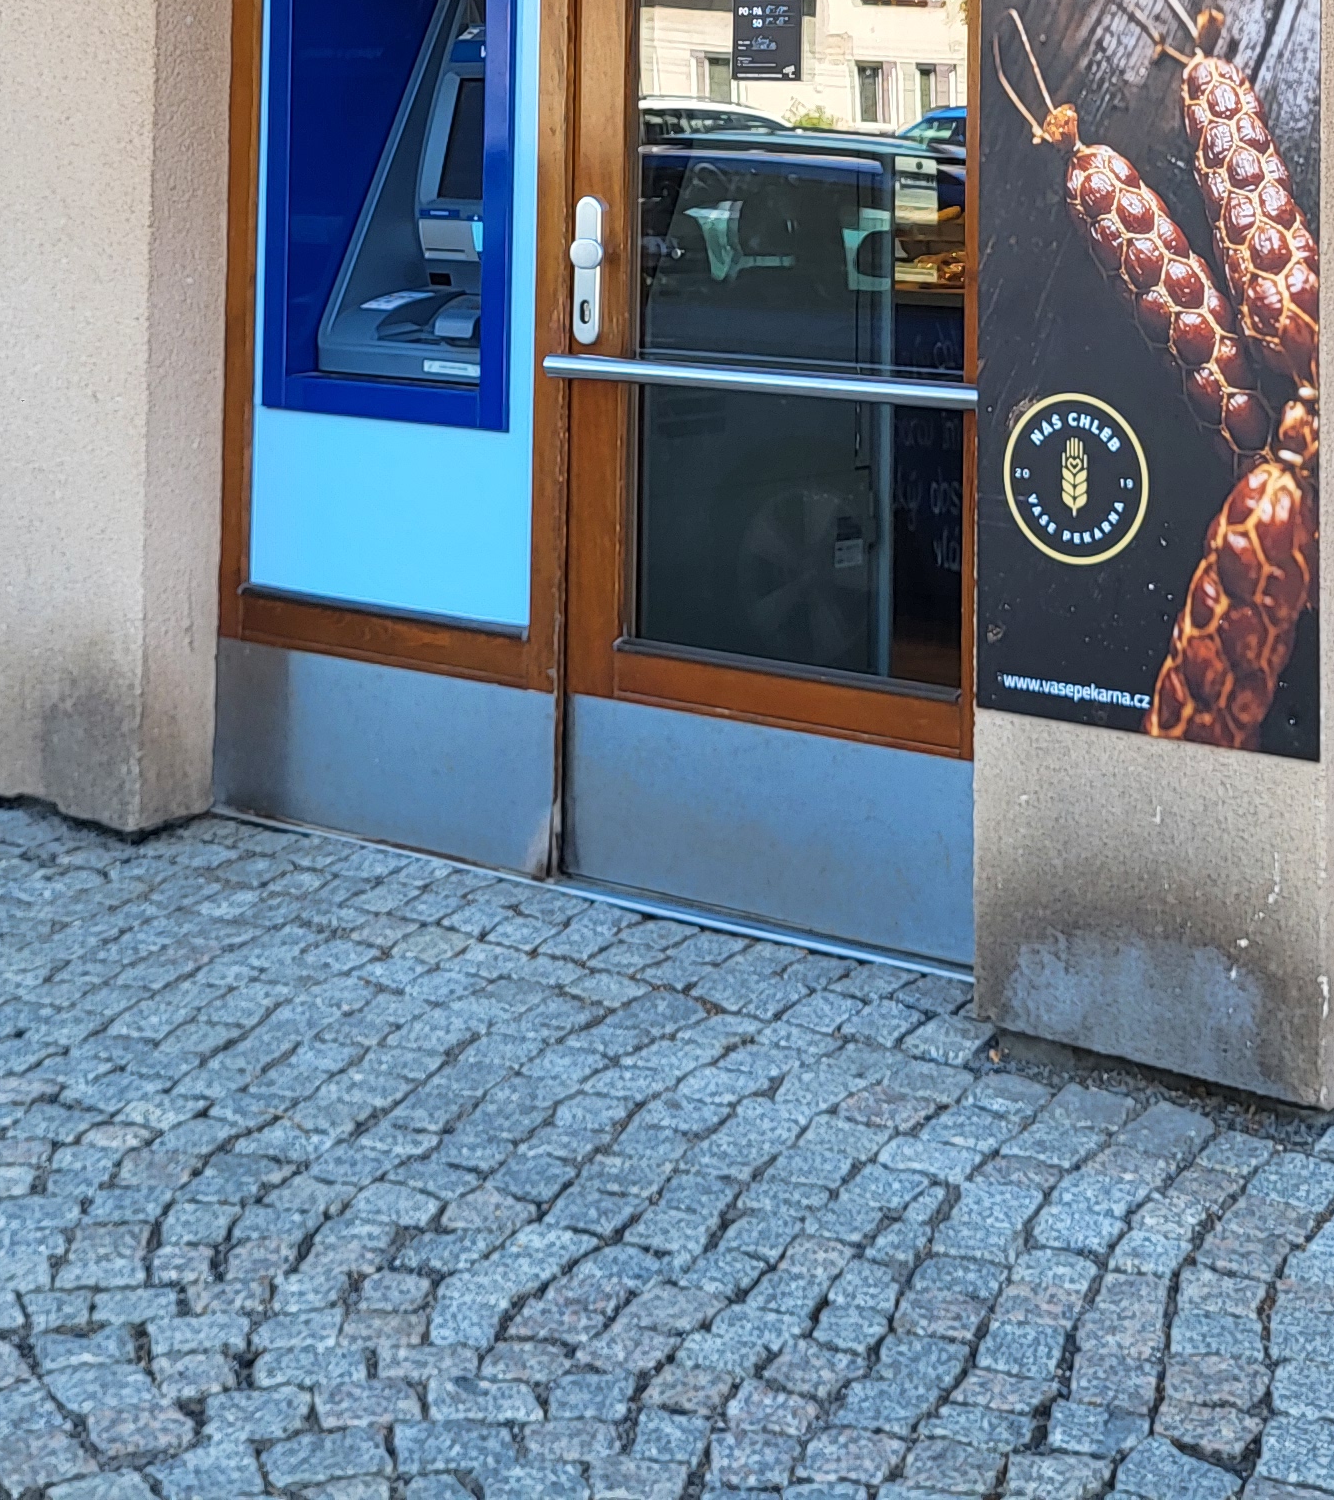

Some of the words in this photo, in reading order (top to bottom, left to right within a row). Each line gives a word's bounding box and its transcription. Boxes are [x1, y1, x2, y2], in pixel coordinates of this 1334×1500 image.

[752, 18, 763, 27] SO
[1014, 467, 1030, 479] 20
[1119, 478, 1134, 489] 19
[1003, 672, 1151, 709] www.vasepekarna.cz
